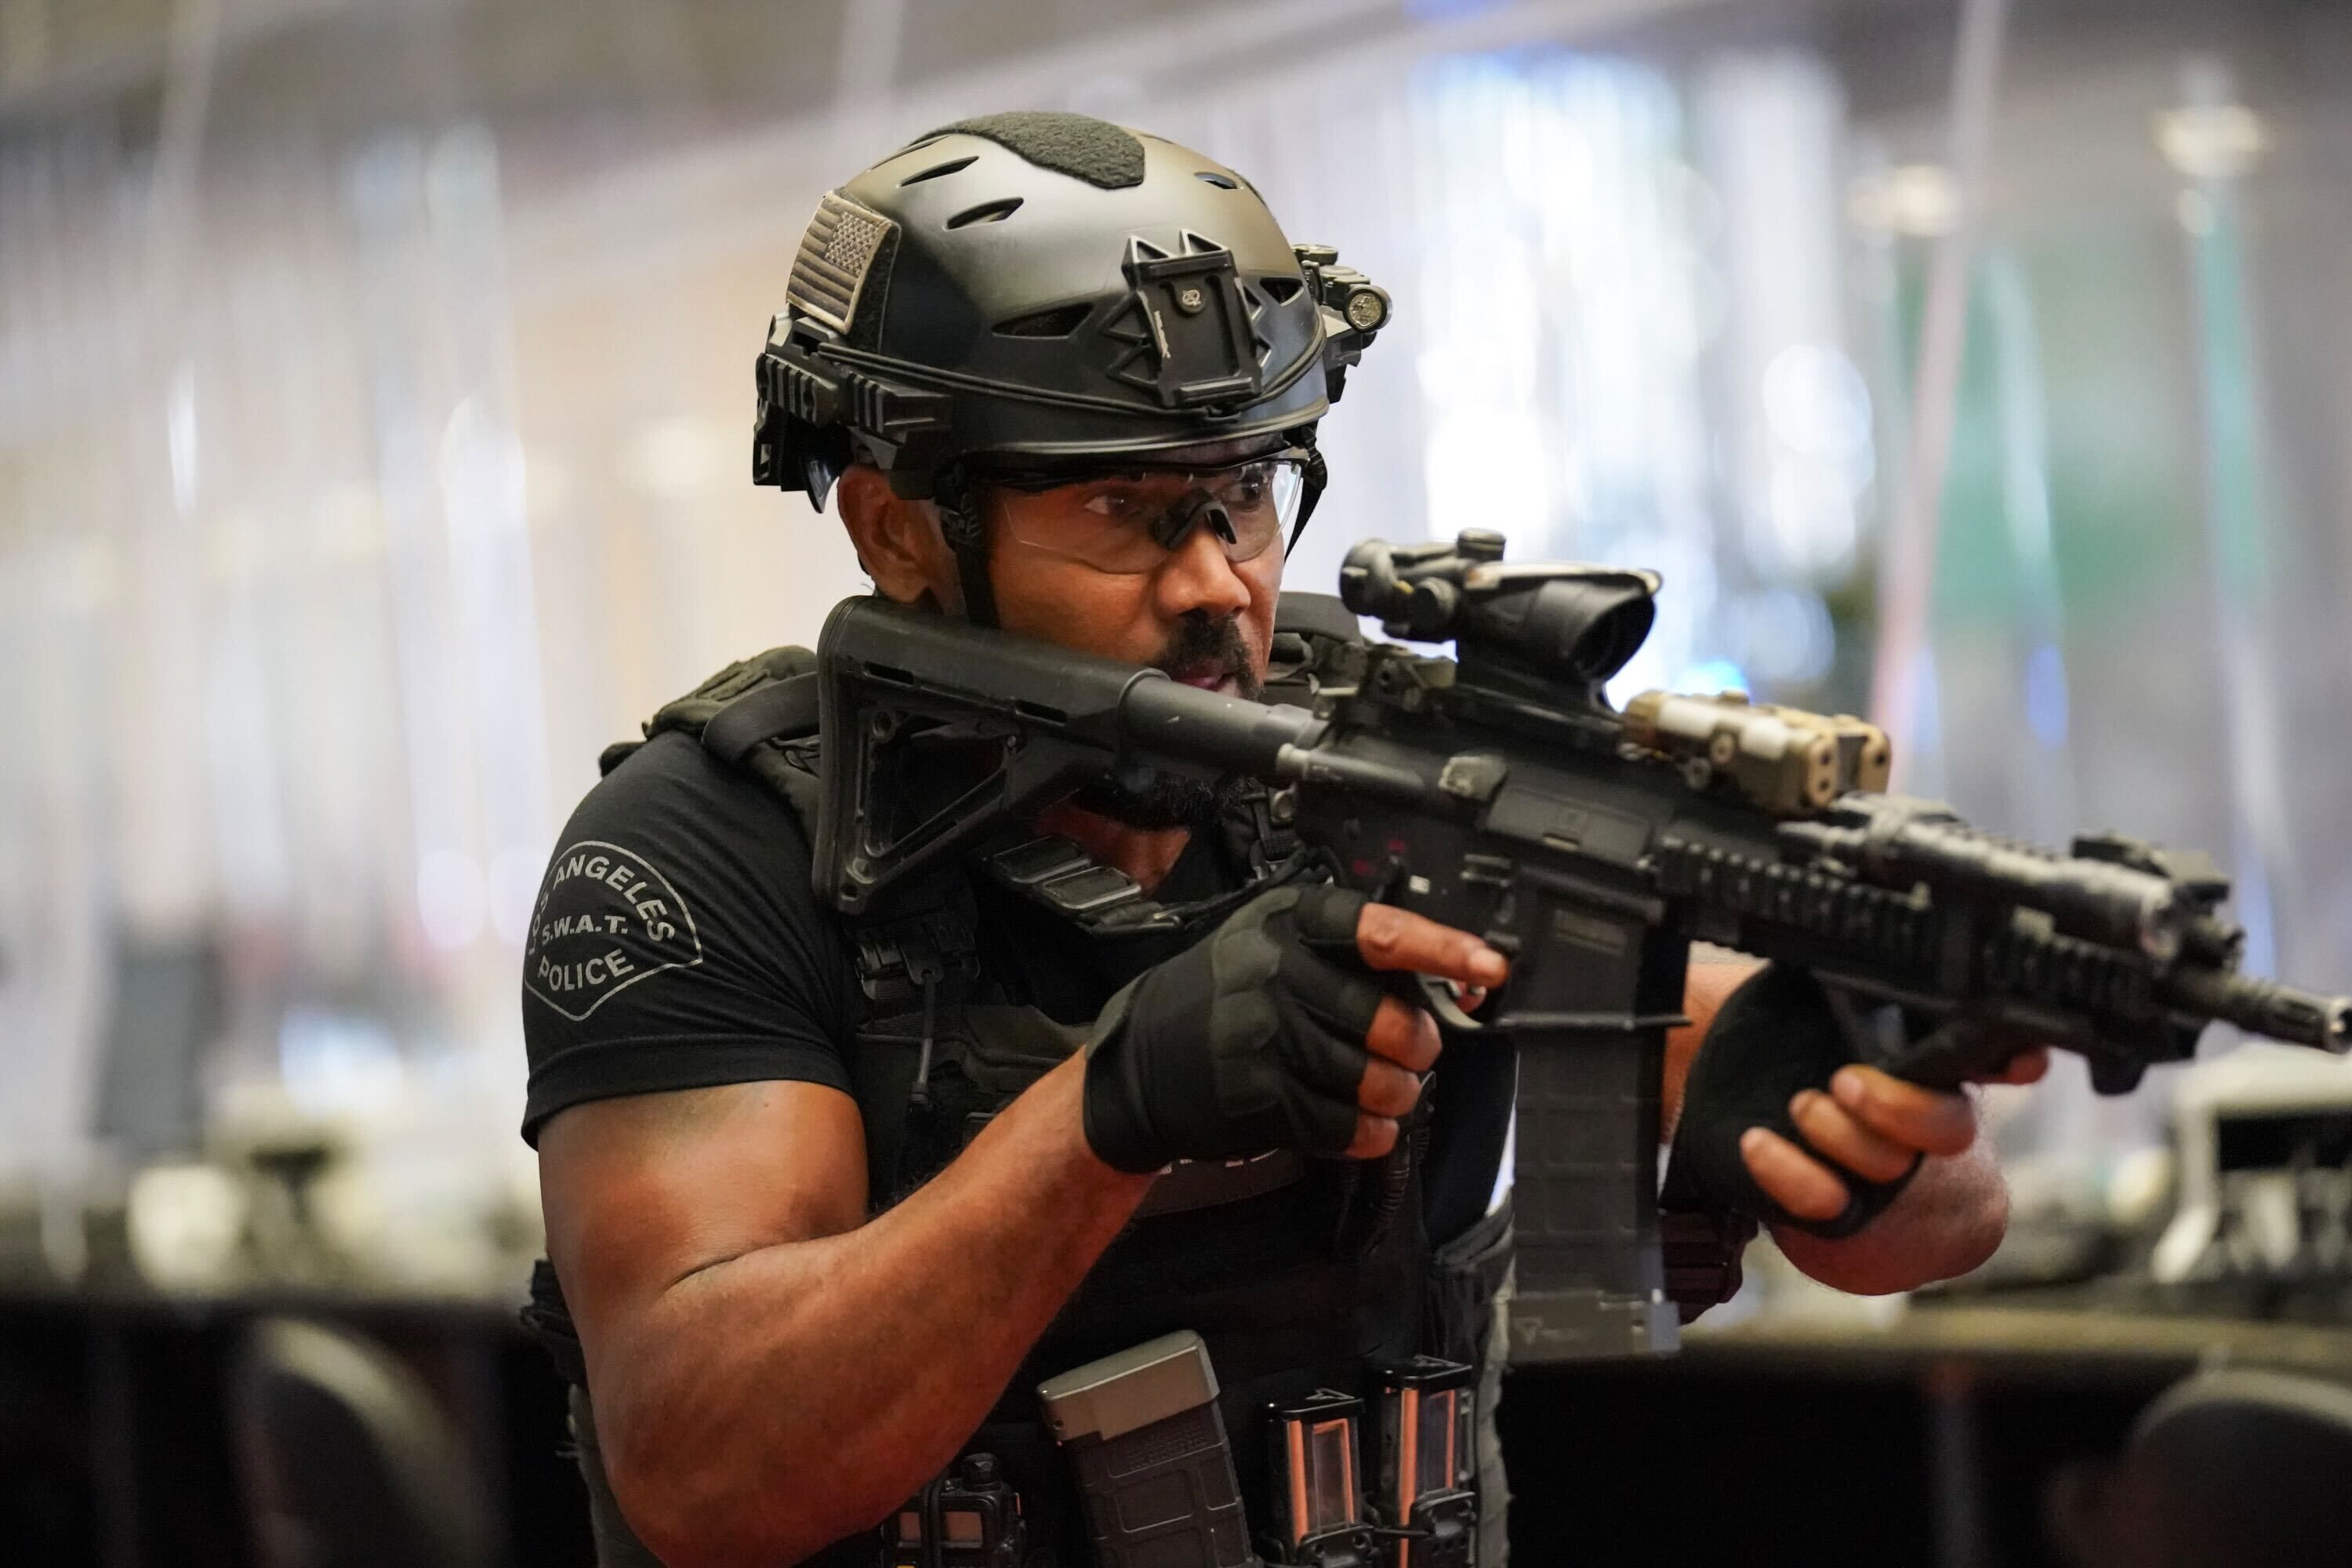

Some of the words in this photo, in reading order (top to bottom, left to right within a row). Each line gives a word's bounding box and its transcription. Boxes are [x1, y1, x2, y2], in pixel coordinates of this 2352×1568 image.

[553, 854, 675, 942] ANGELES
[542, 914, 628, 946] S.W.A.T.
[538, 948, 634, 992] POLICE
